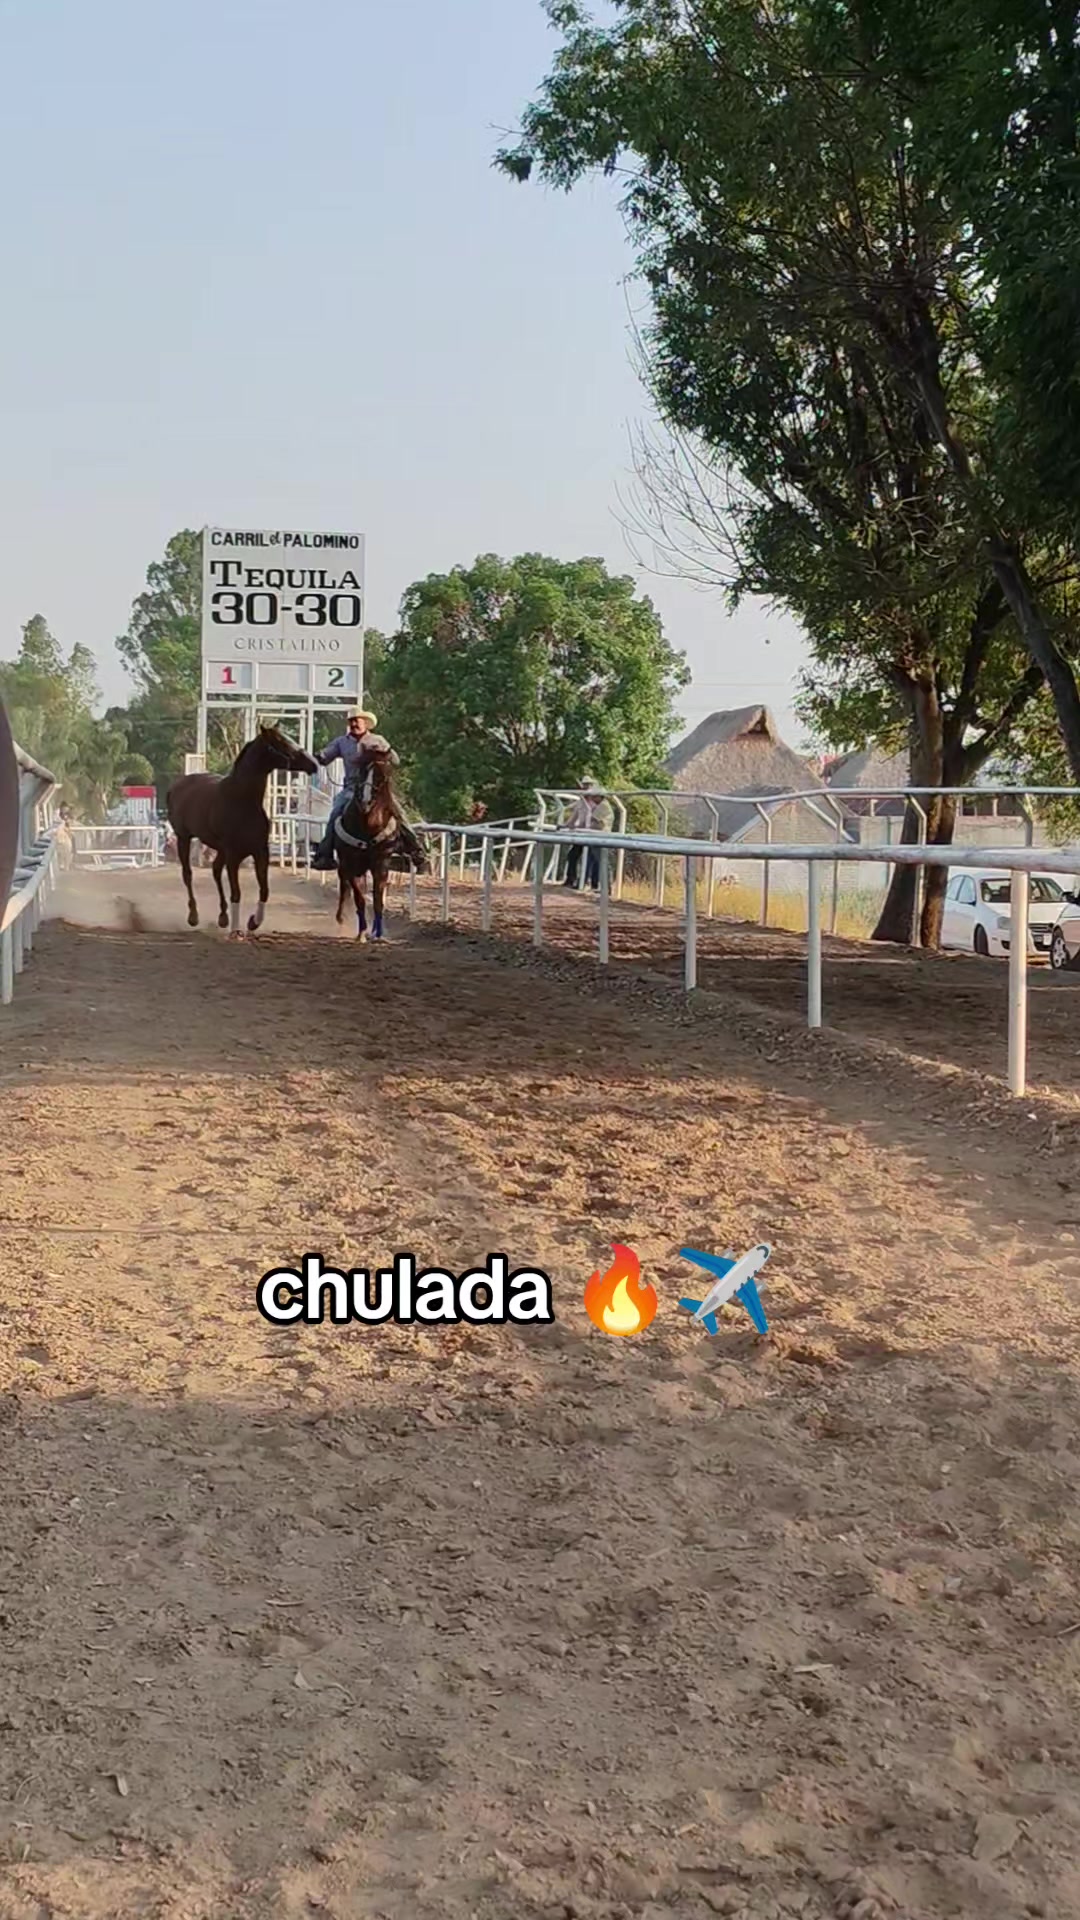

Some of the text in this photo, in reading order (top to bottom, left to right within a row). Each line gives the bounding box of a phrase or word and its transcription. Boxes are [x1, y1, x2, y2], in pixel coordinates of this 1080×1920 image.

[211, 531, 359, 549] CARRIL el PALOMINO
[210, 560, 361, 591] TEQUILA
[211, 591, 361, 627] 30-30
[234, 638, 340, 652] CRISTALINO
[221, 666, 237, 684] 1
[328, 667, 345, 687] 2
